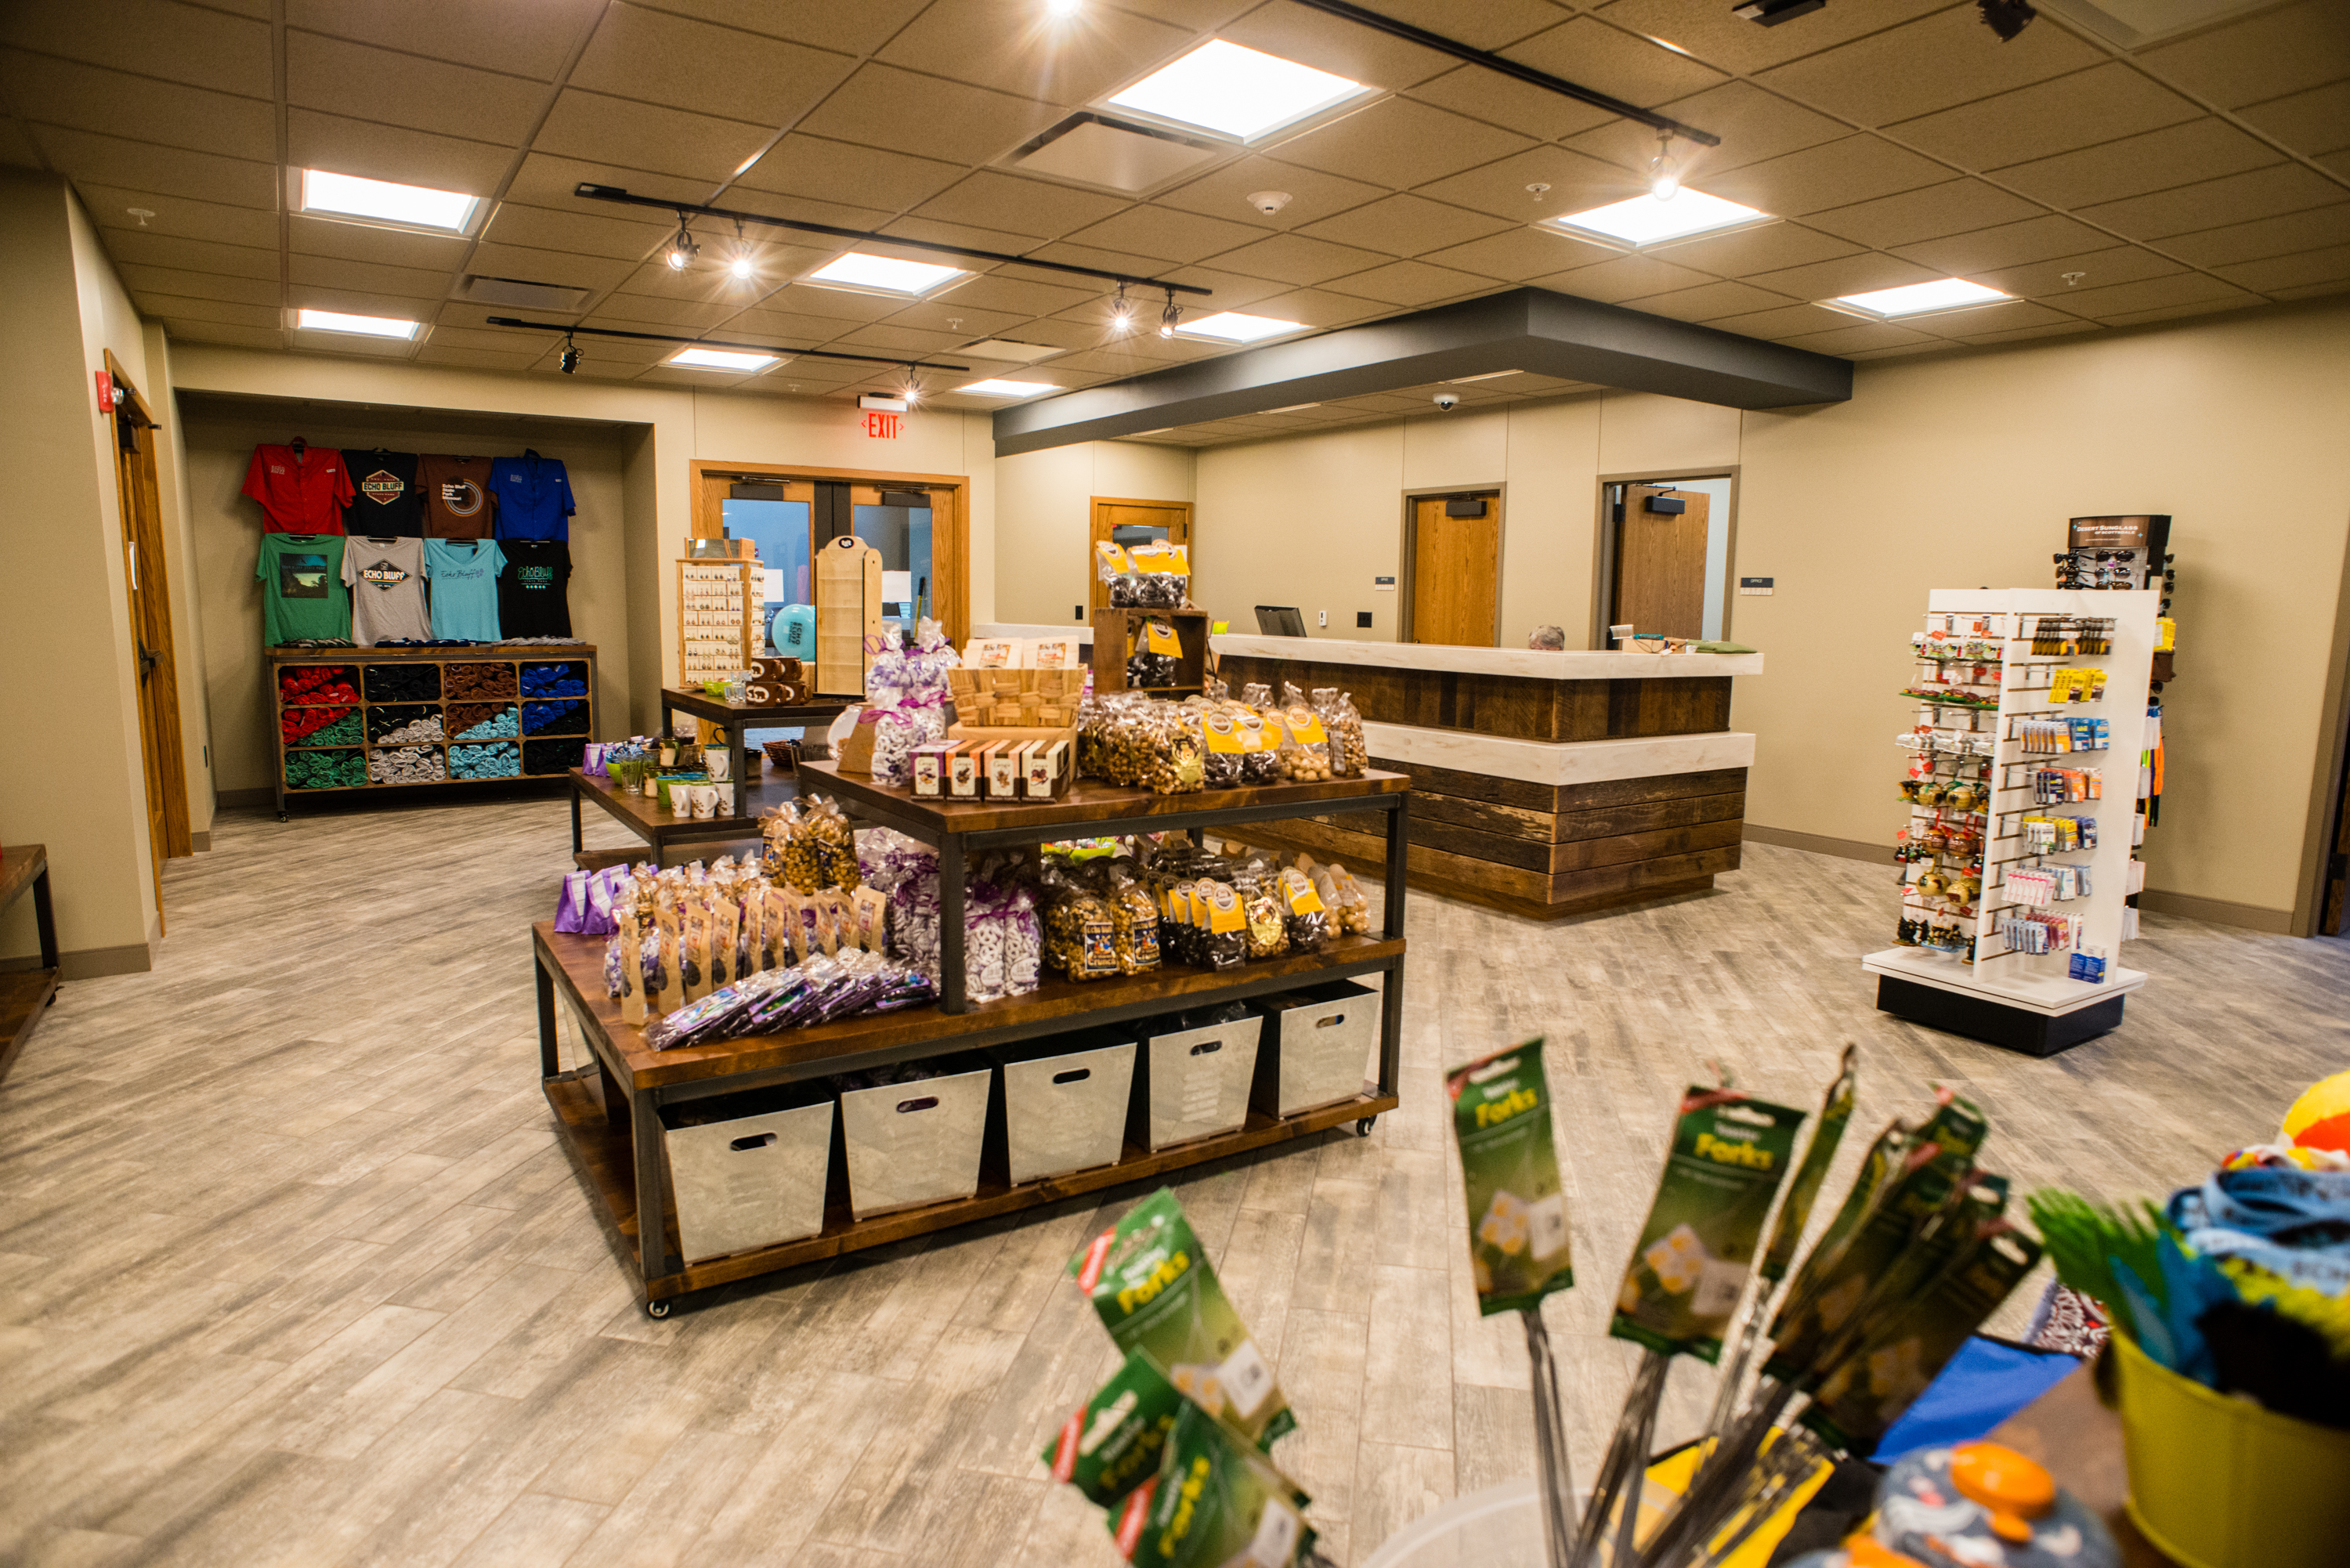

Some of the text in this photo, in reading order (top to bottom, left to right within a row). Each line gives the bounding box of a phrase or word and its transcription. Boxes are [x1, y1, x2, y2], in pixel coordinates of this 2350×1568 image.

[867, 411, 898, 439] EXIT
[363, 569, 406, 580] ECHO BLUFF
[518, 565, 534, 580] Echo
[1475, 1088, 1538, 1128] Forks
[1694, 1133, 1775, 1170] Forks
